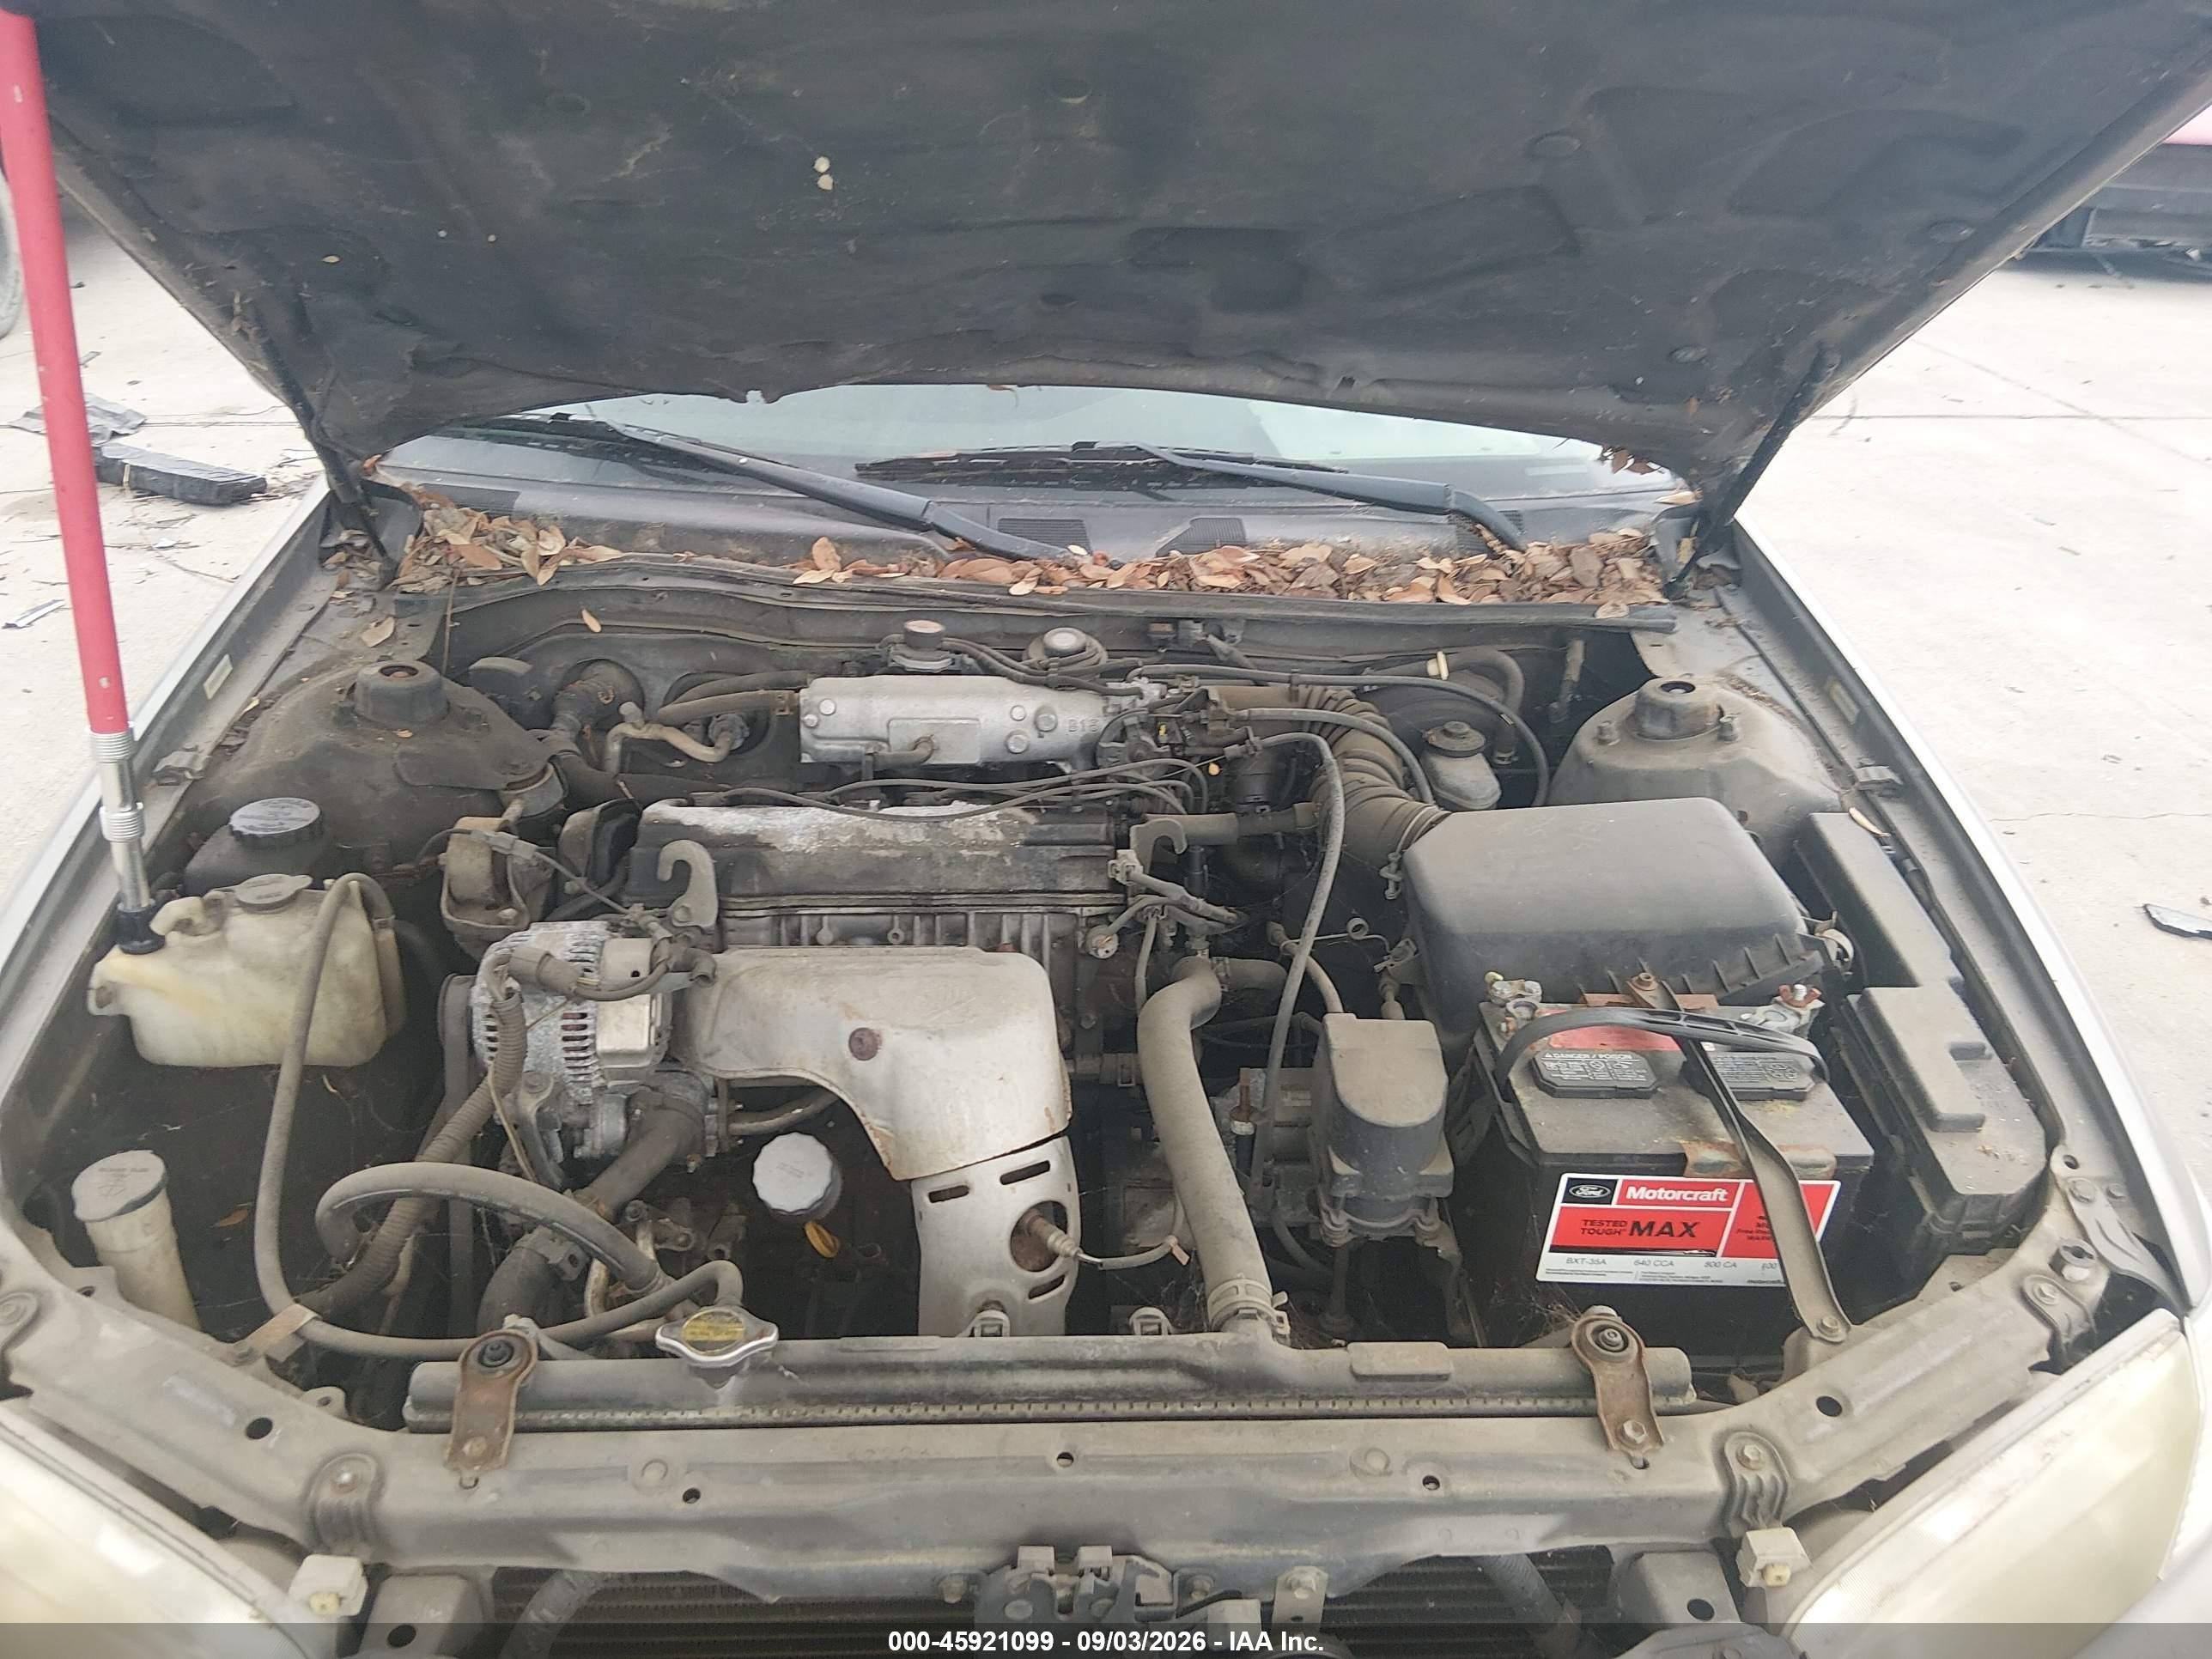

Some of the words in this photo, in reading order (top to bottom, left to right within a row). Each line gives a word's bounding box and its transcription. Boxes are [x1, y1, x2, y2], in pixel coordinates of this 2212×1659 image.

[1572, 1184, 1607, 1197] Ford
[1626, 1186, 1729, 1202] Motorcraft
[1582, 1218, 1628, 1228] TESTED
[1628, 1220, 1699, 1238] MAX
[1633, 1259, 1651, 1267] 640
[1653, 1259, 1674, 1267] CCA
[1723, 1261, 1737, 1269] CA
